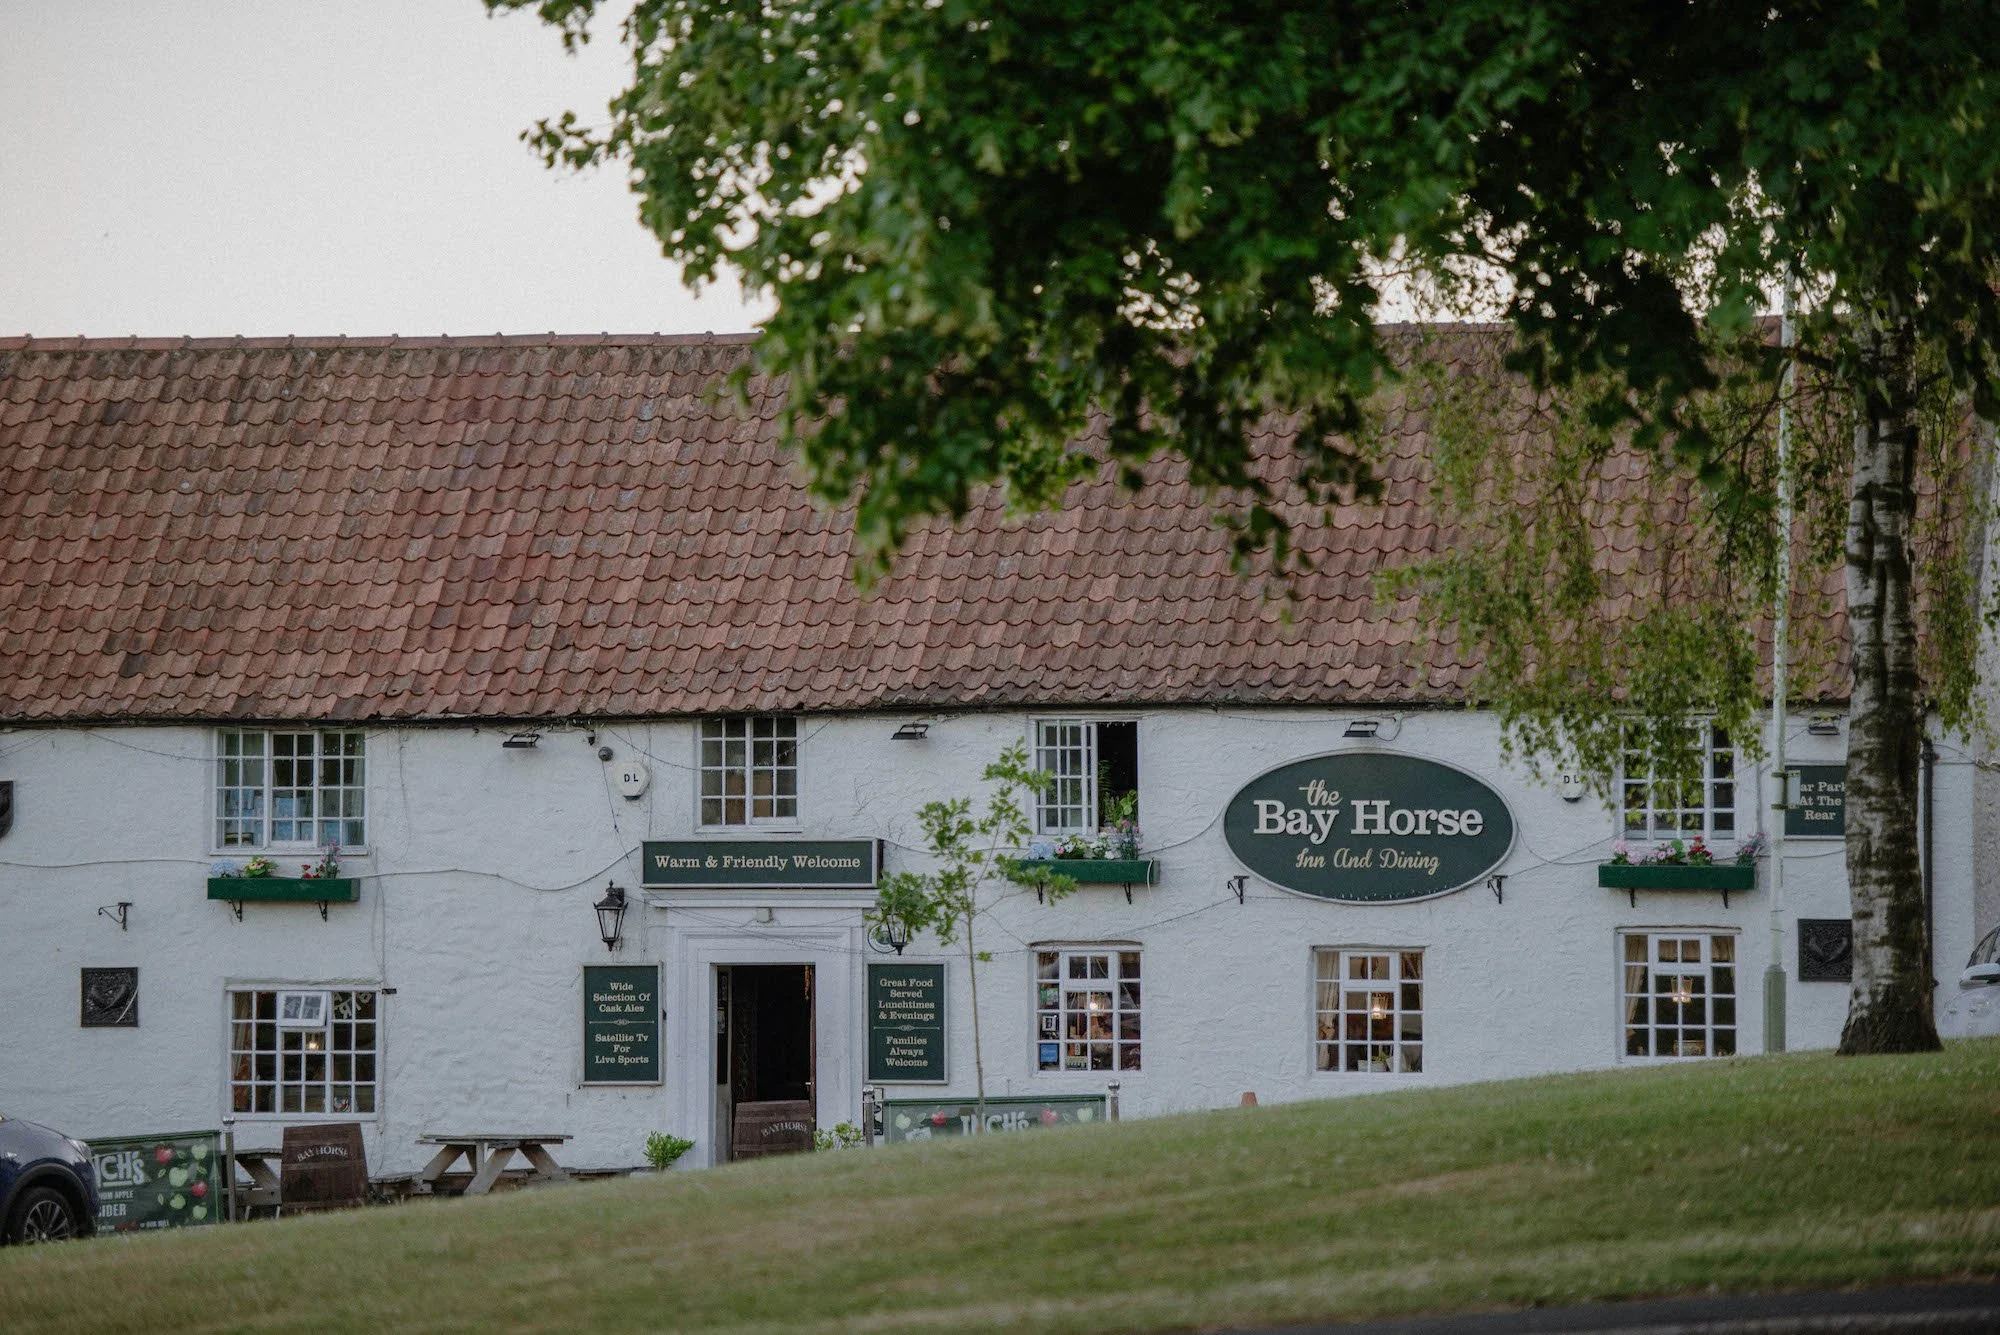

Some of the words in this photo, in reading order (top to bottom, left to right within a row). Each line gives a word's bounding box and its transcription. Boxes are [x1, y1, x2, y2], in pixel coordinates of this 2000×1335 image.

[1299, 779, 1342, 807] the
[1800, 796, 1813, 806] At
[1817, 796, 1842, 806] The
[1804, 810, 1836, 820] Rear
[1253, 799, 1340, 845] Bay
[1350, 799, 1484, 836] Horse
[655, 855, 700, 868] Warm
[705, 855, 718, 868] &
[722, 855, 788, 872] Friendly
[792, 855, 861, 868] Welcome
[1295, 847, 1326, 869] Inn
[1333, 848, 1372, 869] And
[1379, 848, 1440, 875] Dining
[610, 982, 634, 991] Wide
[880, 978, 907, 987] Great
[909, 978, 934, 987] Food
[593, 993, 636, 1002] Selection
[638, 993, 651, 1002] Of
[890, 989, 923, 998] Served
[599, 1004, 622, 1013] Cask
[624, 1004, 645, 1013] Ales
[878, 1000, 935, 1009] Lunchtimes
[879, 1011, 888, 1020] &
[890, 1011, 935, 1021] Evenings
[595, 1033, 634, 1042] Satellite
[636, 1033, 649, 1042] Tv
[886, 1036, 928, 1045] Families
[613, 1044, 631, 1053] For
[890, 1047, 924, 1057] Always
[595, 1055, 616, 1064] Live
[618, 1055, 649, 1066] Sports
[885, 1058, 929, 1067] Welcome
